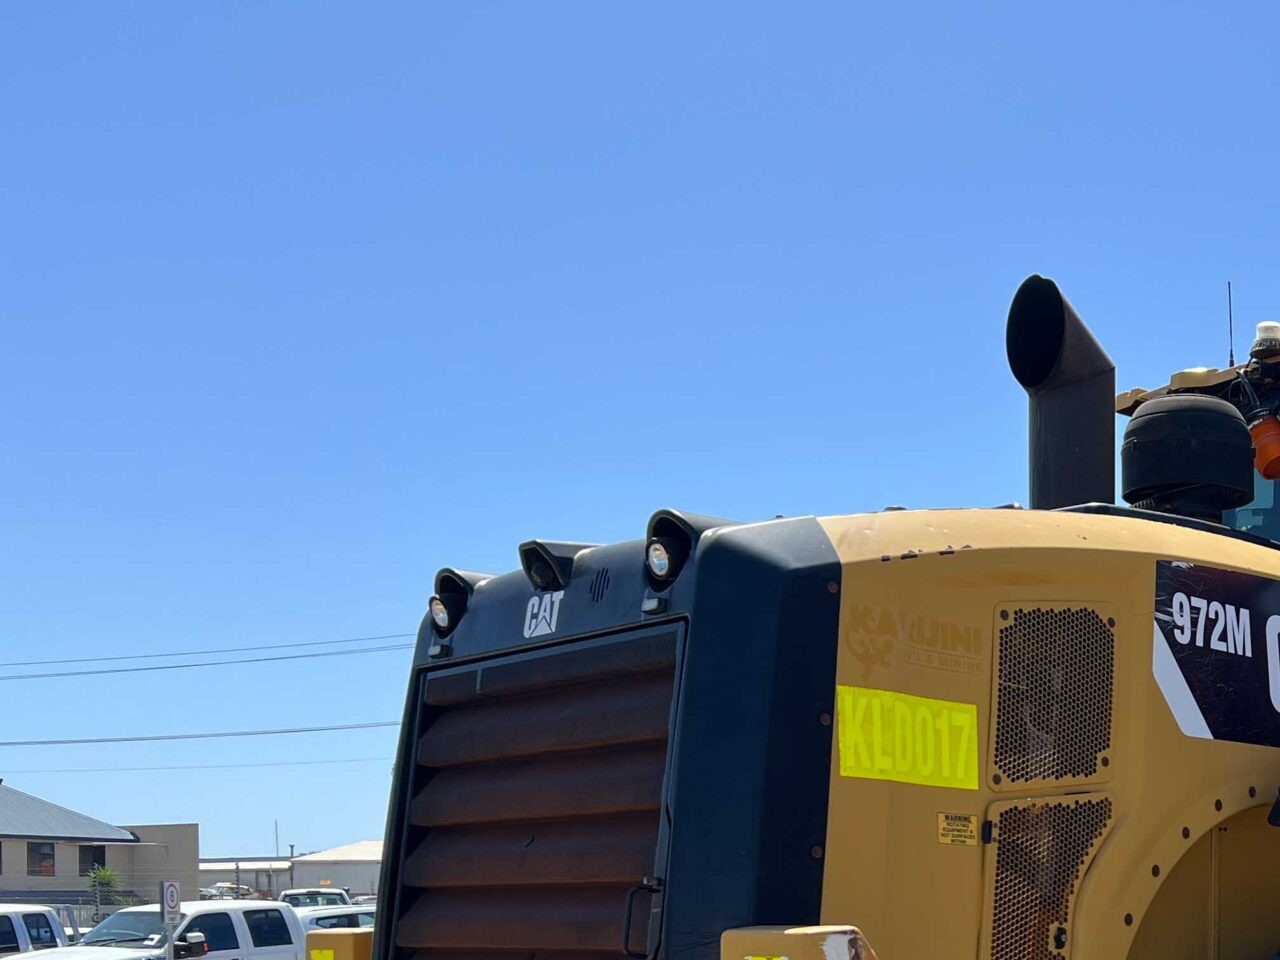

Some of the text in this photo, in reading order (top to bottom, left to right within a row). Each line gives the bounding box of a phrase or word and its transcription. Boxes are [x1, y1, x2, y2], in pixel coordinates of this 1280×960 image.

[523, 590, 564, 638] CAT
[1172, 591, 1252, 658] 972M
[844, 693, 972, 779] KLD017
[944, 814, 971, 823] WARNING
